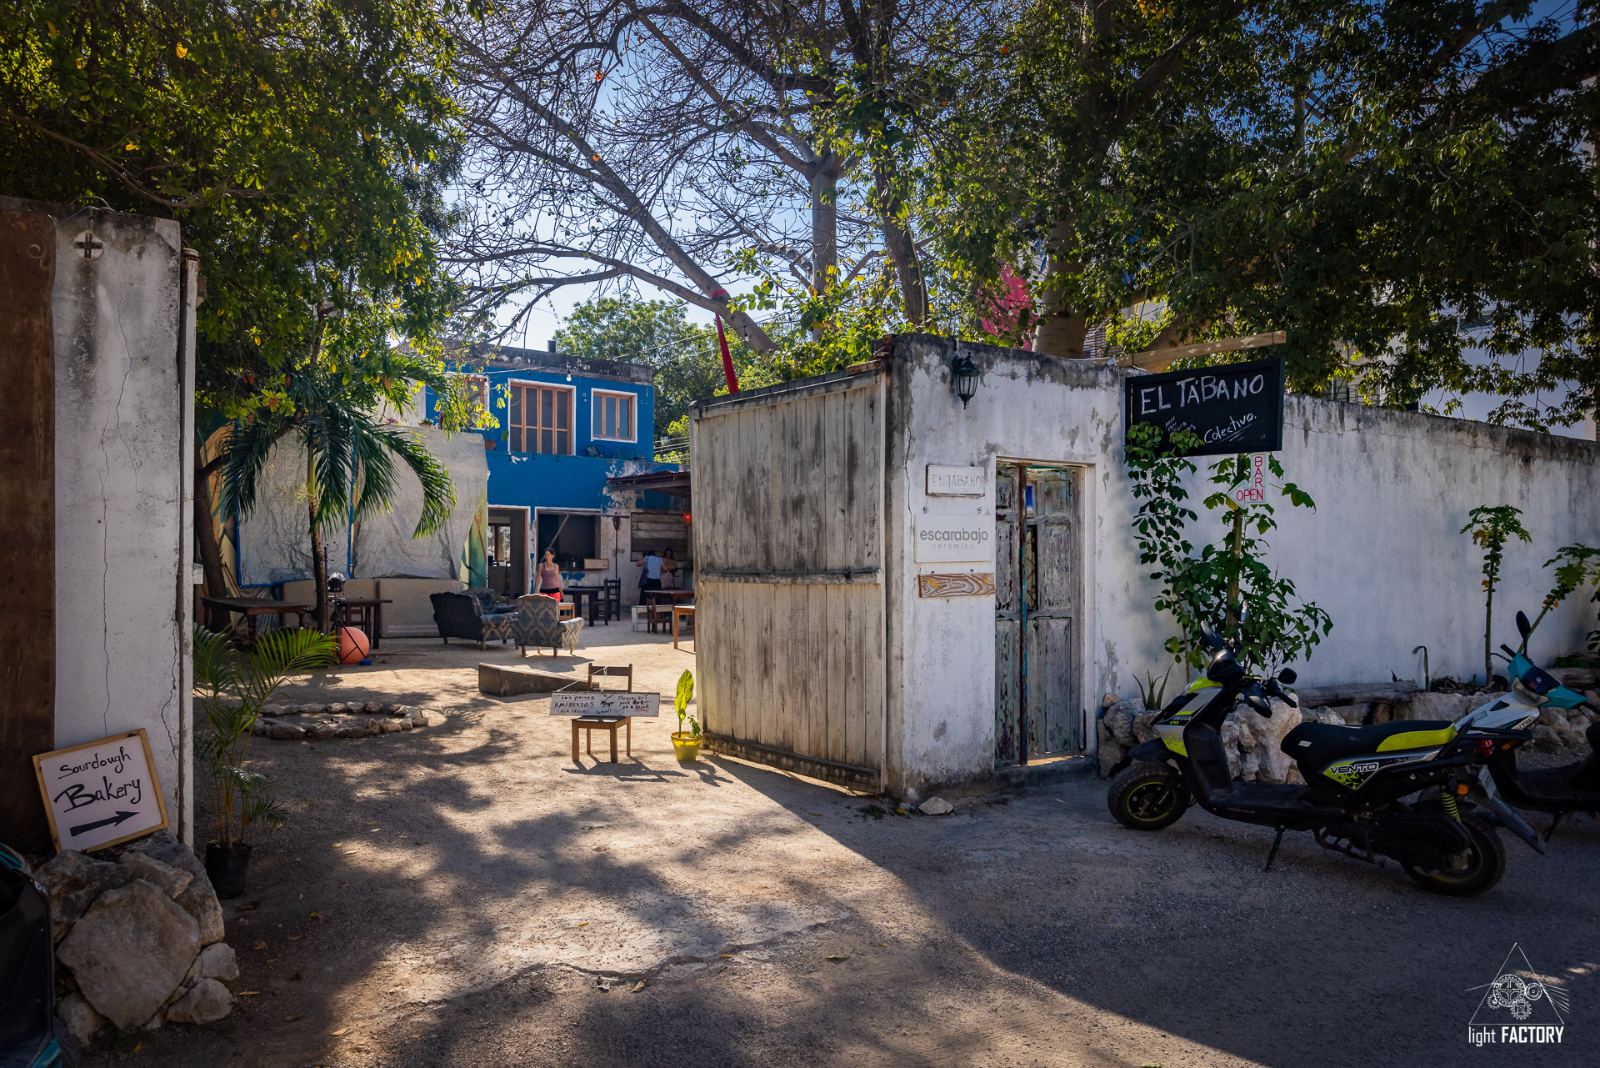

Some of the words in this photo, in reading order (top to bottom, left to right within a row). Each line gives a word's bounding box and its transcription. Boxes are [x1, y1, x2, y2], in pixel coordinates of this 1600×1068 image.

[1141, 387, 1171, 415] EL
[1254, 456, 1263, 488] BAR
[1236, 489, 1264, 502] OPEN
[919, 527, 989, 544] escarabajo
[57, 745, 132, 780] Sourdough
[1330, 761, 1379, 774] VENTO
[53, 775, 141, 813] Bakery
